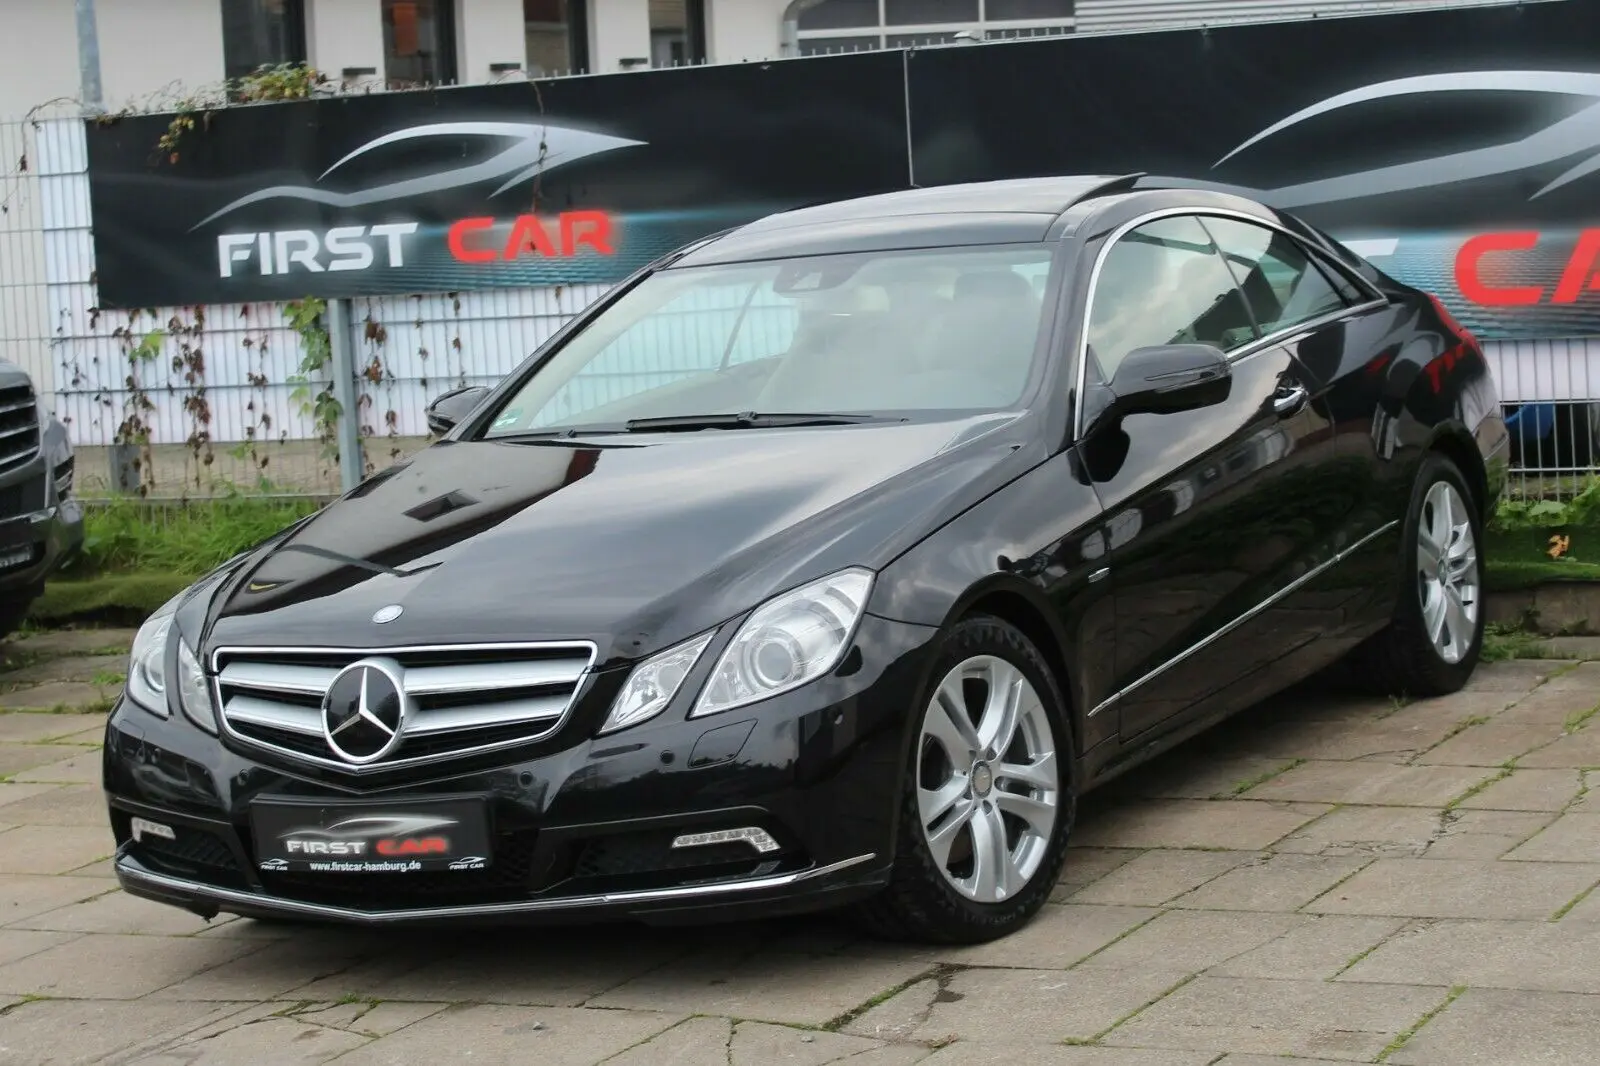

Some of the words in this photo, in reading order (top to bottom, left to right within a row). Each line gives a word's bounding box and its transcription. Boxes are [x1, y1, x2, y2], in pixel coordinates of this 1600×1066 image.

[218, 223, 418, 278] FIRST
[447, 210, 614, 264] CAR
[286, 840, 366, 855] FIRST
[376, 837, 446, 855] CAR
[309, 861, 421, 872] www.firstcar-hamburg.de
